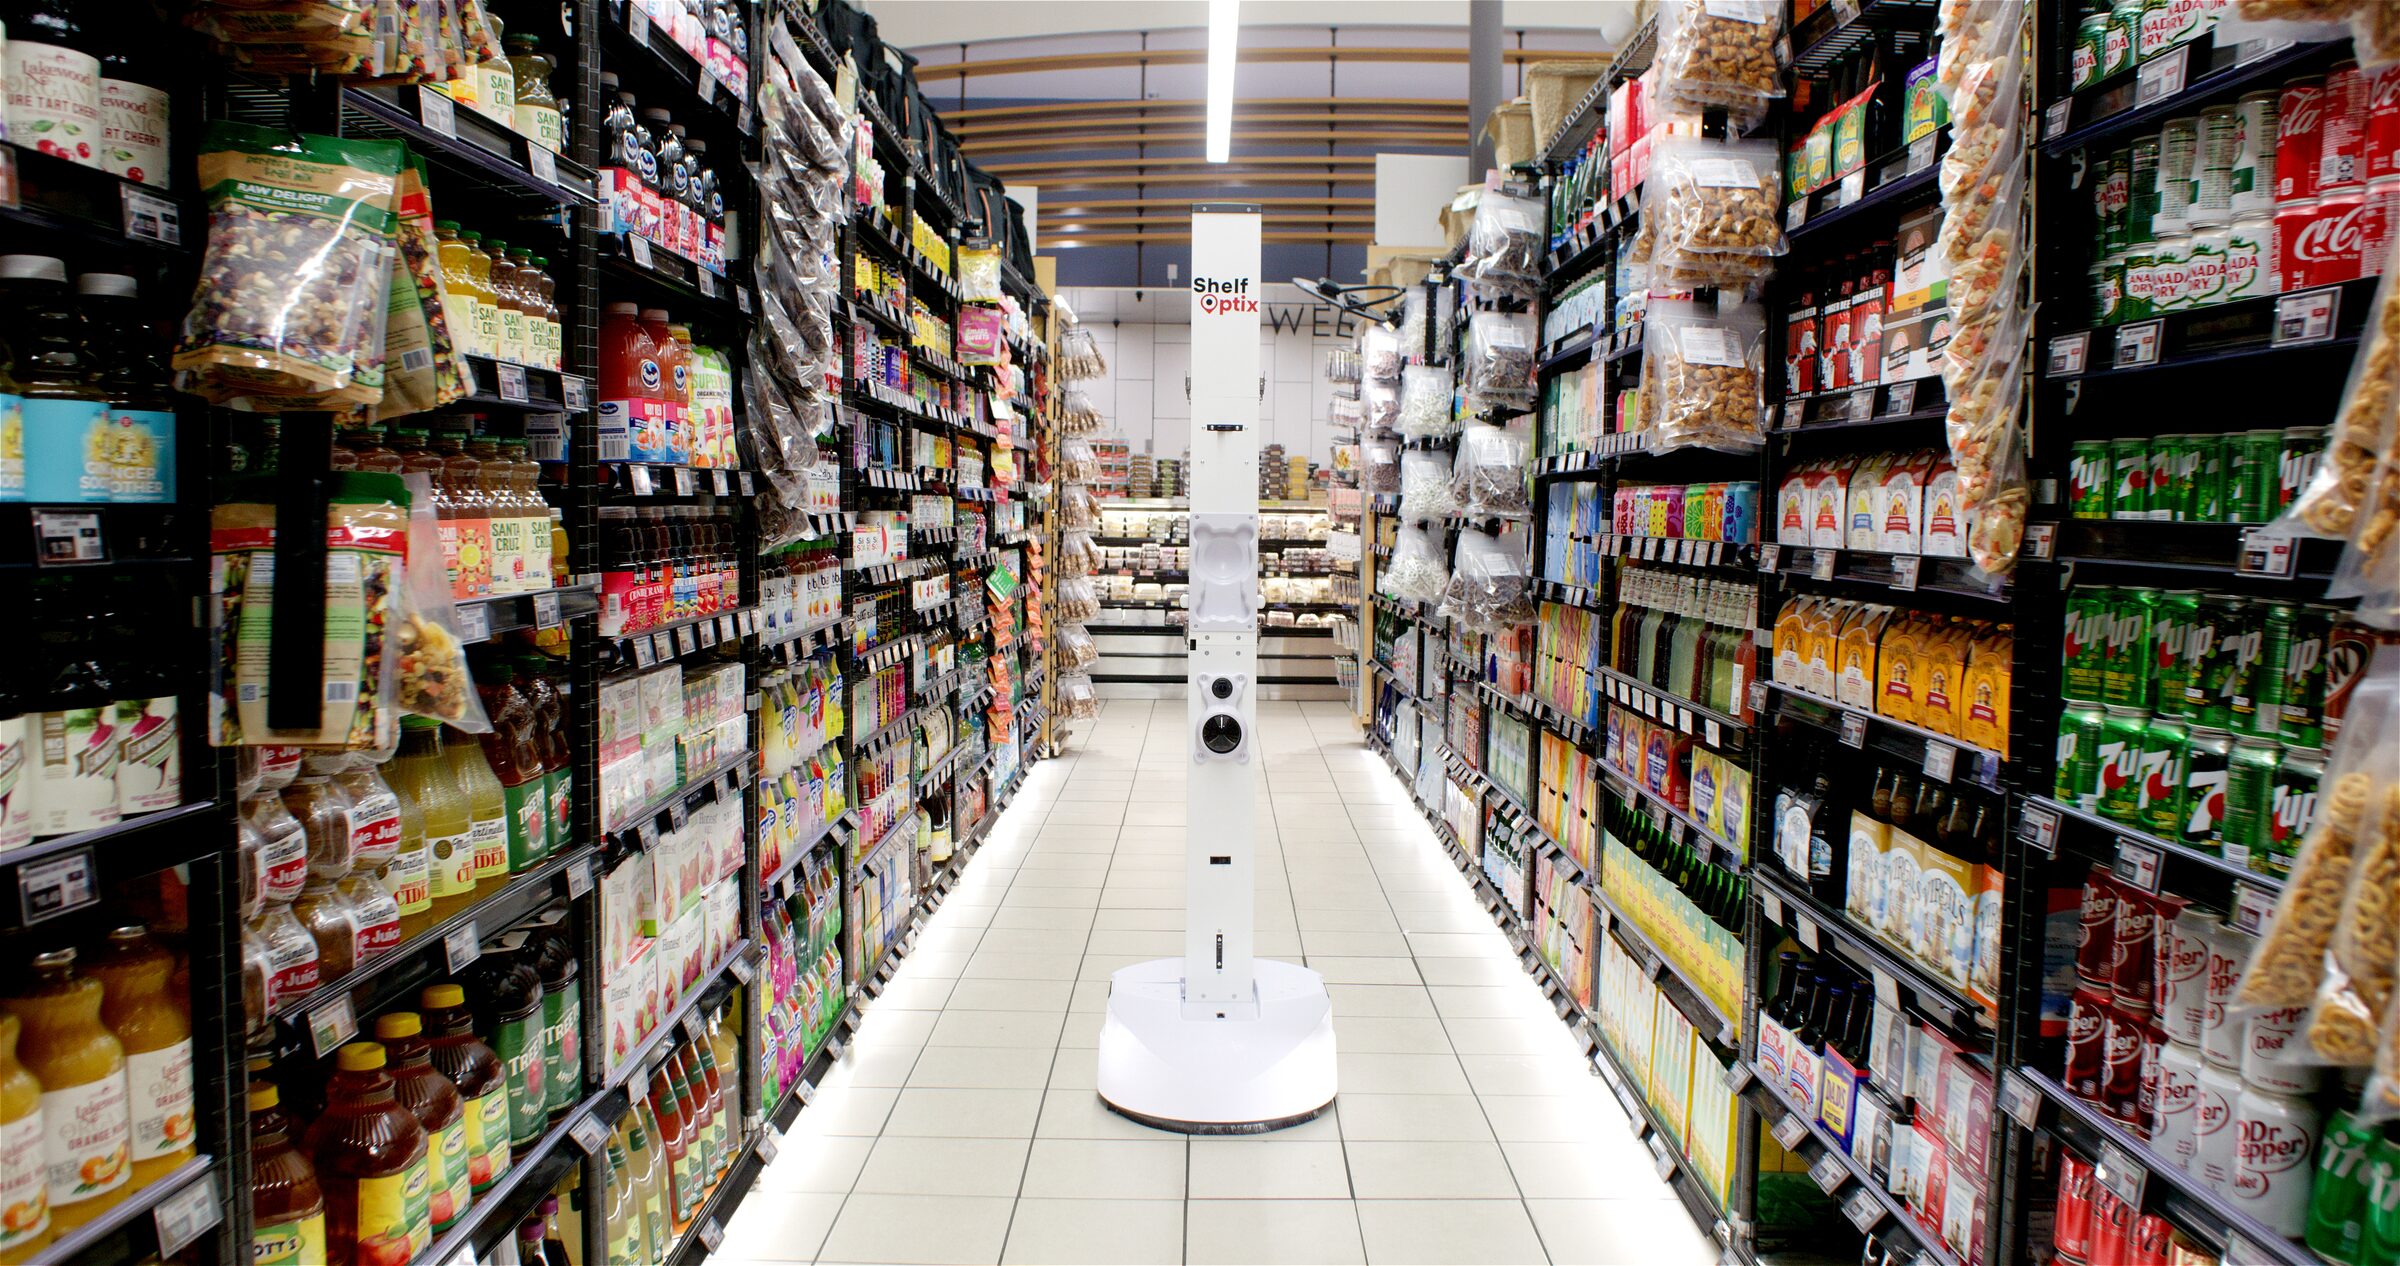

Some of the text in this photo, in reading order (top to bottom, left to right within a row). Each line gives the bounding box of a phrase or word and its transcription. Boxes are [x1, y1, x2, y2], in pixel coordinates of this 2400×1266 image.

[22, 60, 92, 86] Lakewood
[38, 97, 69, 112] TART
[124, 130, 161, 148] CHERRY
[237, 182, 333, 205] RAW DELIGHT
[1193, 277, 1248, 293] Shelf
[1200, 294, 1258, 315] Optix
[2250, 1120, 2281, 1141] Dr
